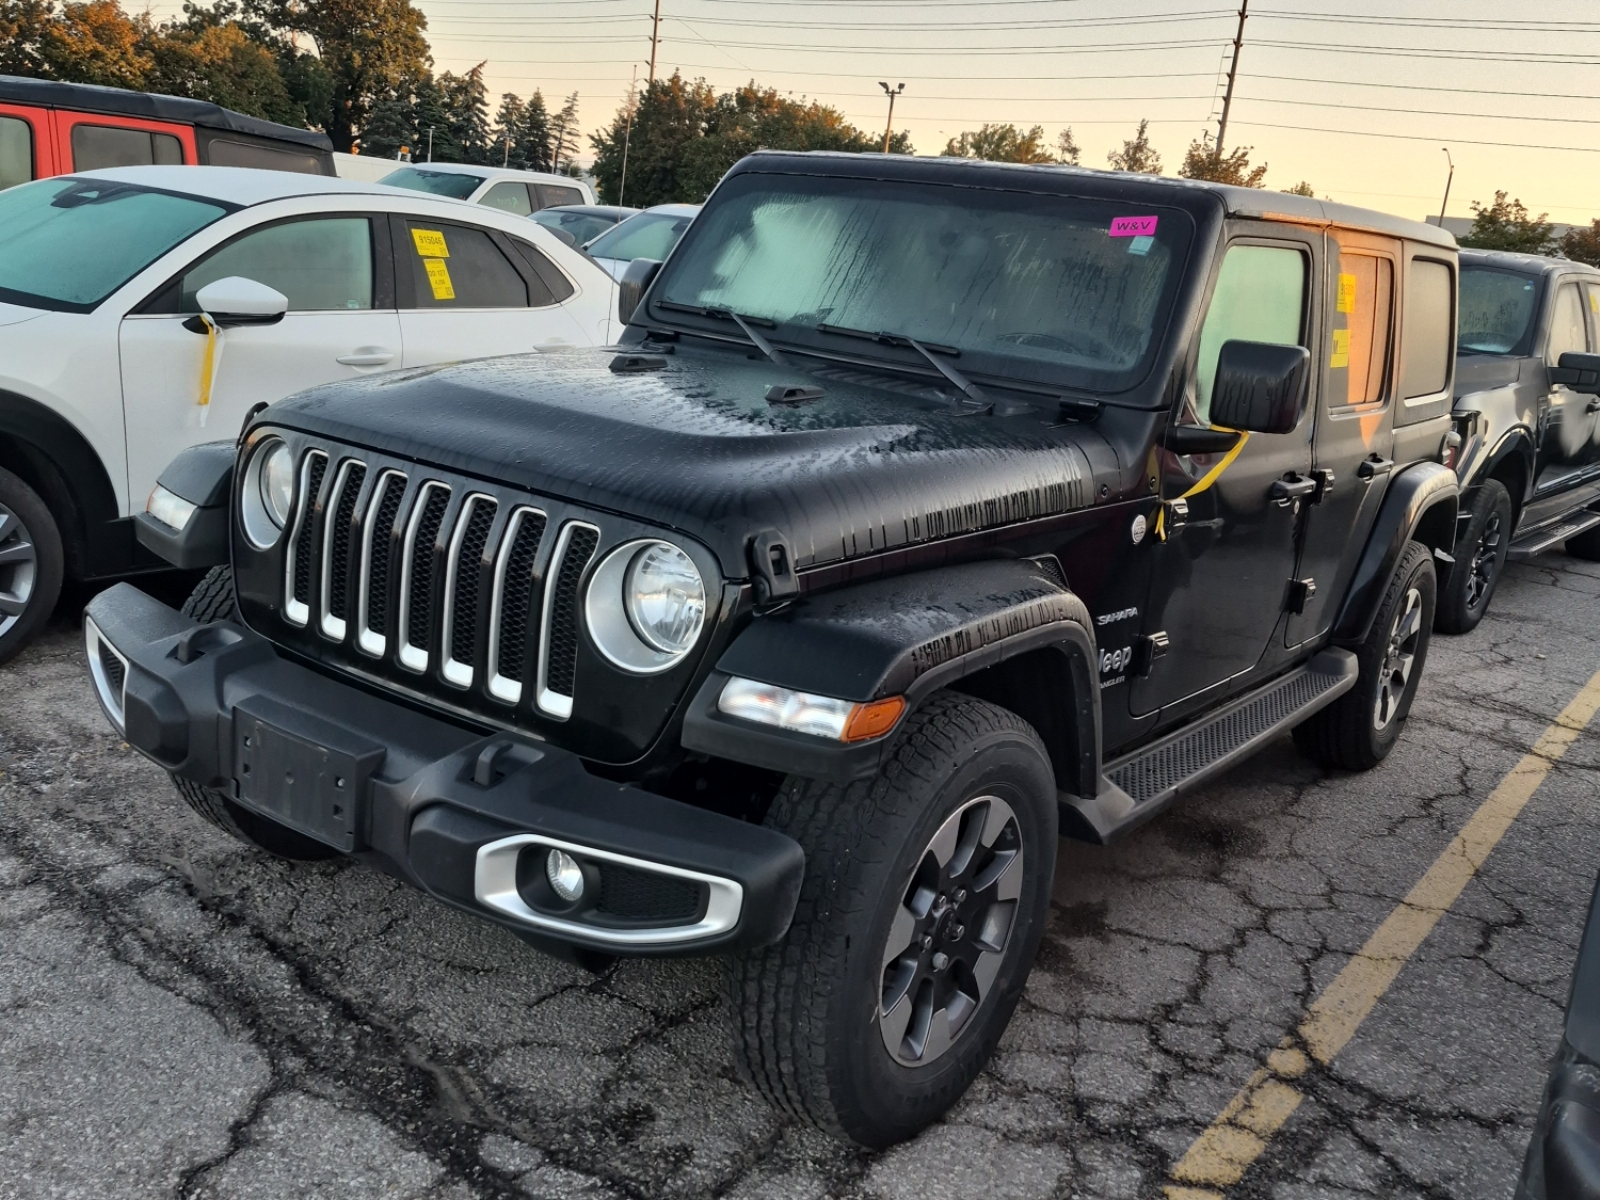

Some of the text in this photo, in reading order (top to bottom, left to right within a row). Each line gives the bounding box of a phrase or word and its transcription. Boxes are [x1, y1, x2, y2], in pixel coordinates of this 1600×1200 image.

[1117, 221, 1151, 231] W&V
[1096, 607, 1138, 625] SAHARA
[1098, 646, 1132, 673] Jeep
[1099, 675, 1125, 689] ANGLER
